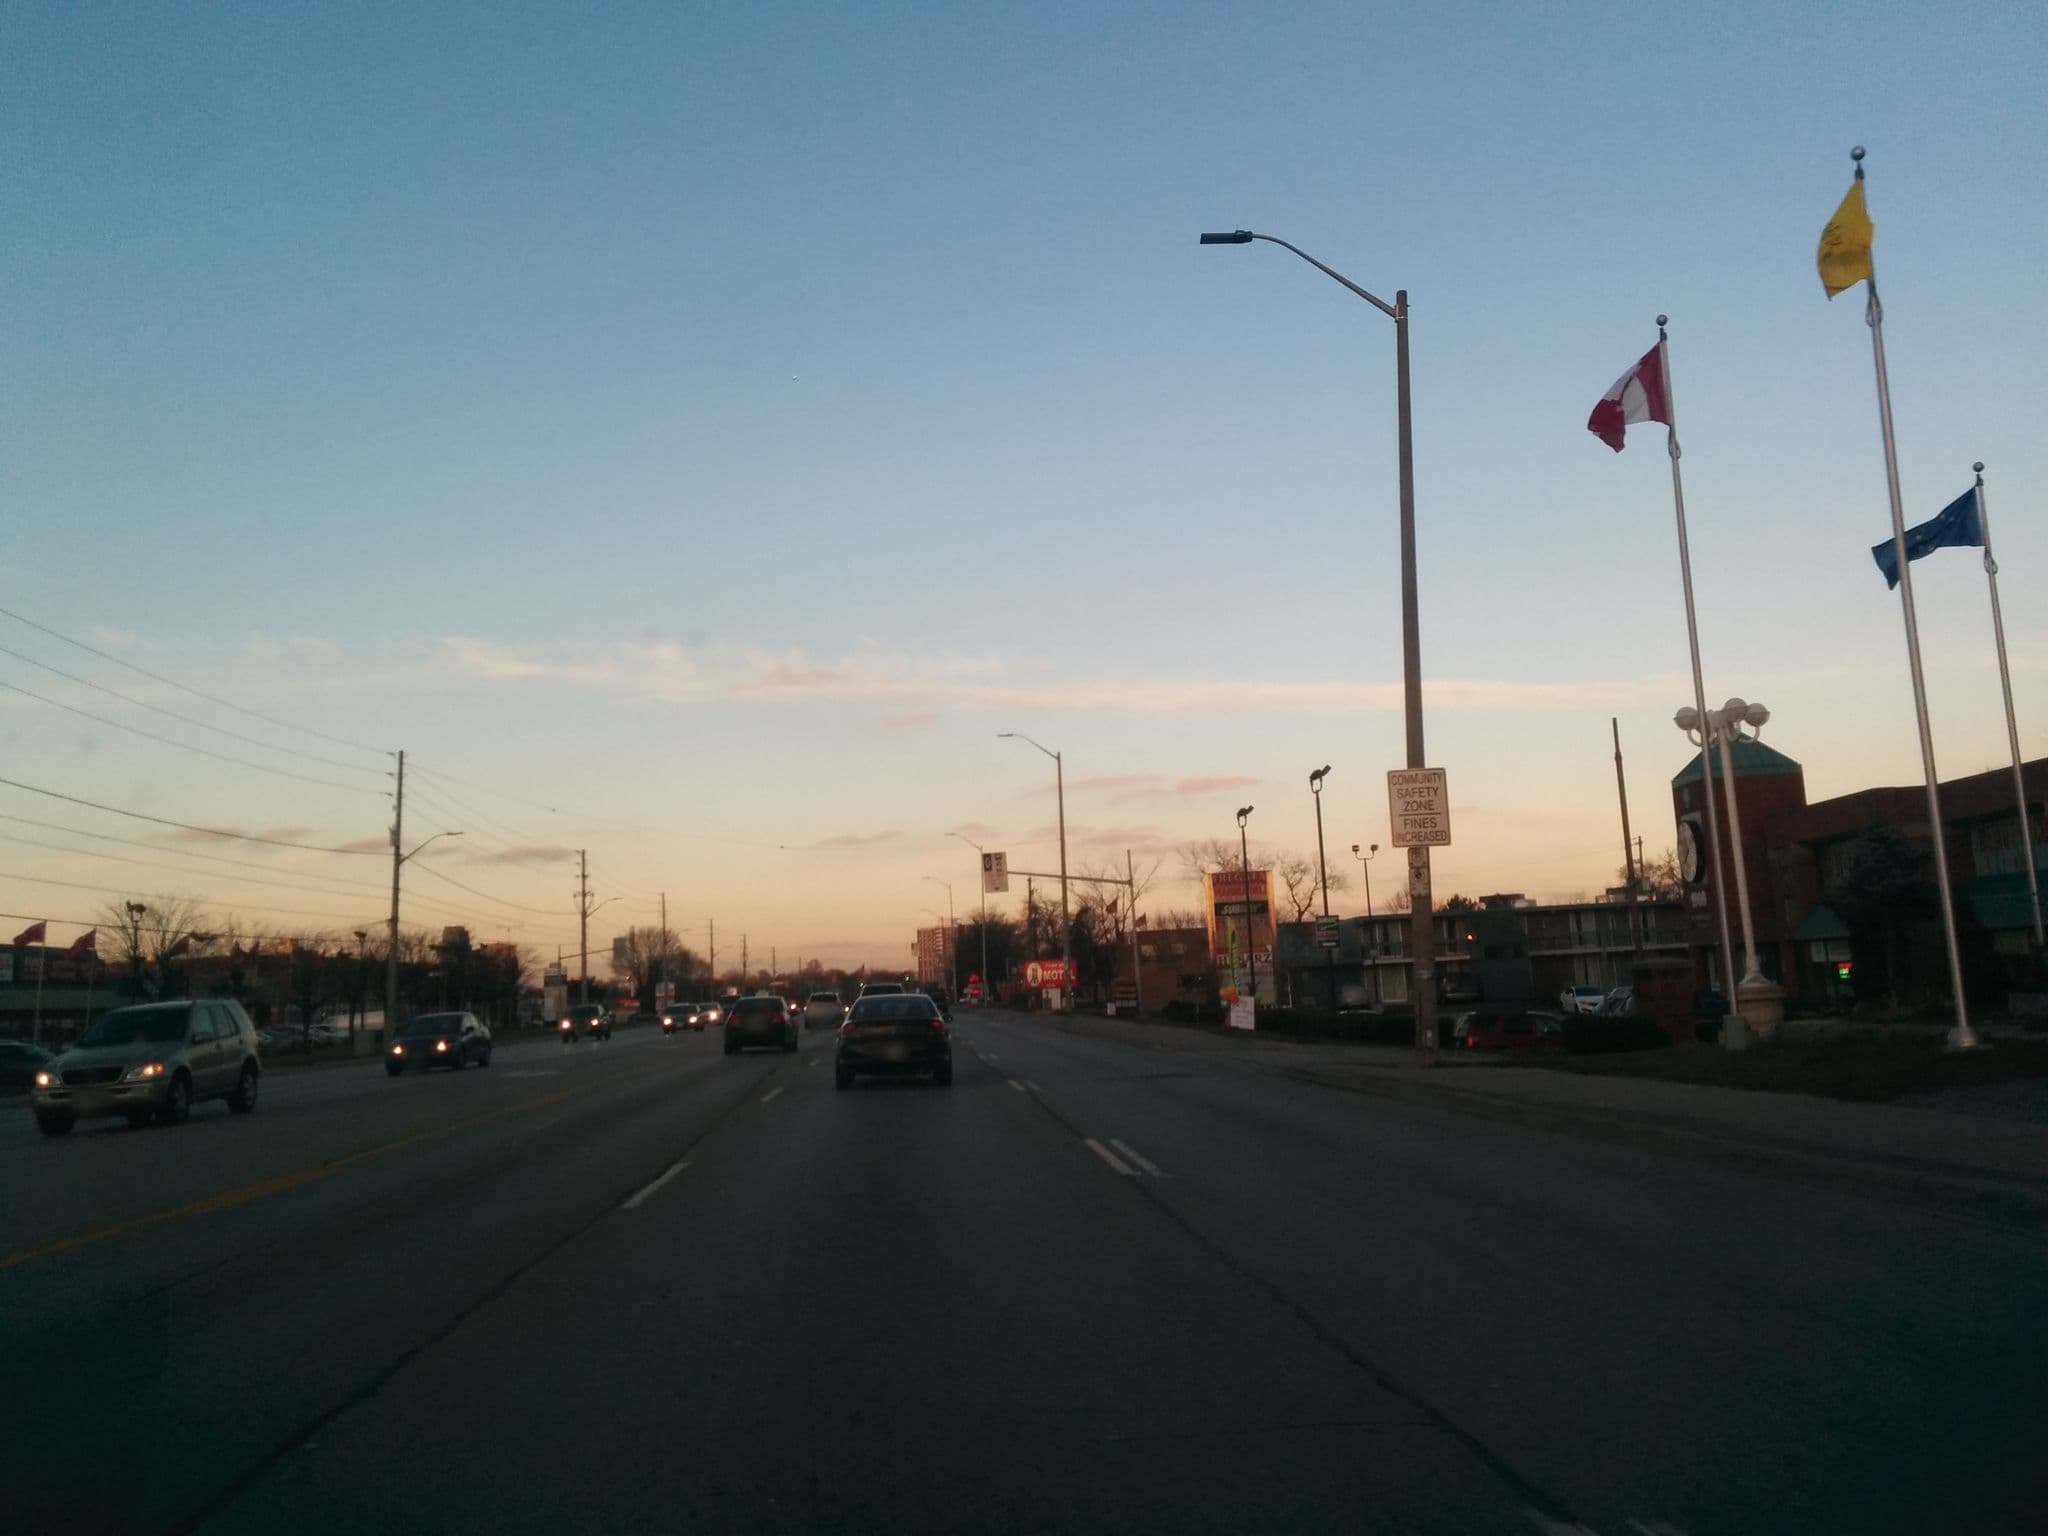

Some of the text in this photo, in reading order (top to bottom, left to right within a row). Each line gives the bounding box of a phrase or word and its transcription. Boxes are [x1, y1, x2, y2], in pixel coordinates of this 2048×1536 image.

[1391, 772, 1442, 786] COMMUNITY
[1396, 786, 1440, 800] SAFETY
[1403, 800, 1435, 812] ZONE
[1403, 817, 1438, 830] FINES
[1395, 830, 1448, 843] INCREASED
[1043, 969, 1077, 981] MOTL
